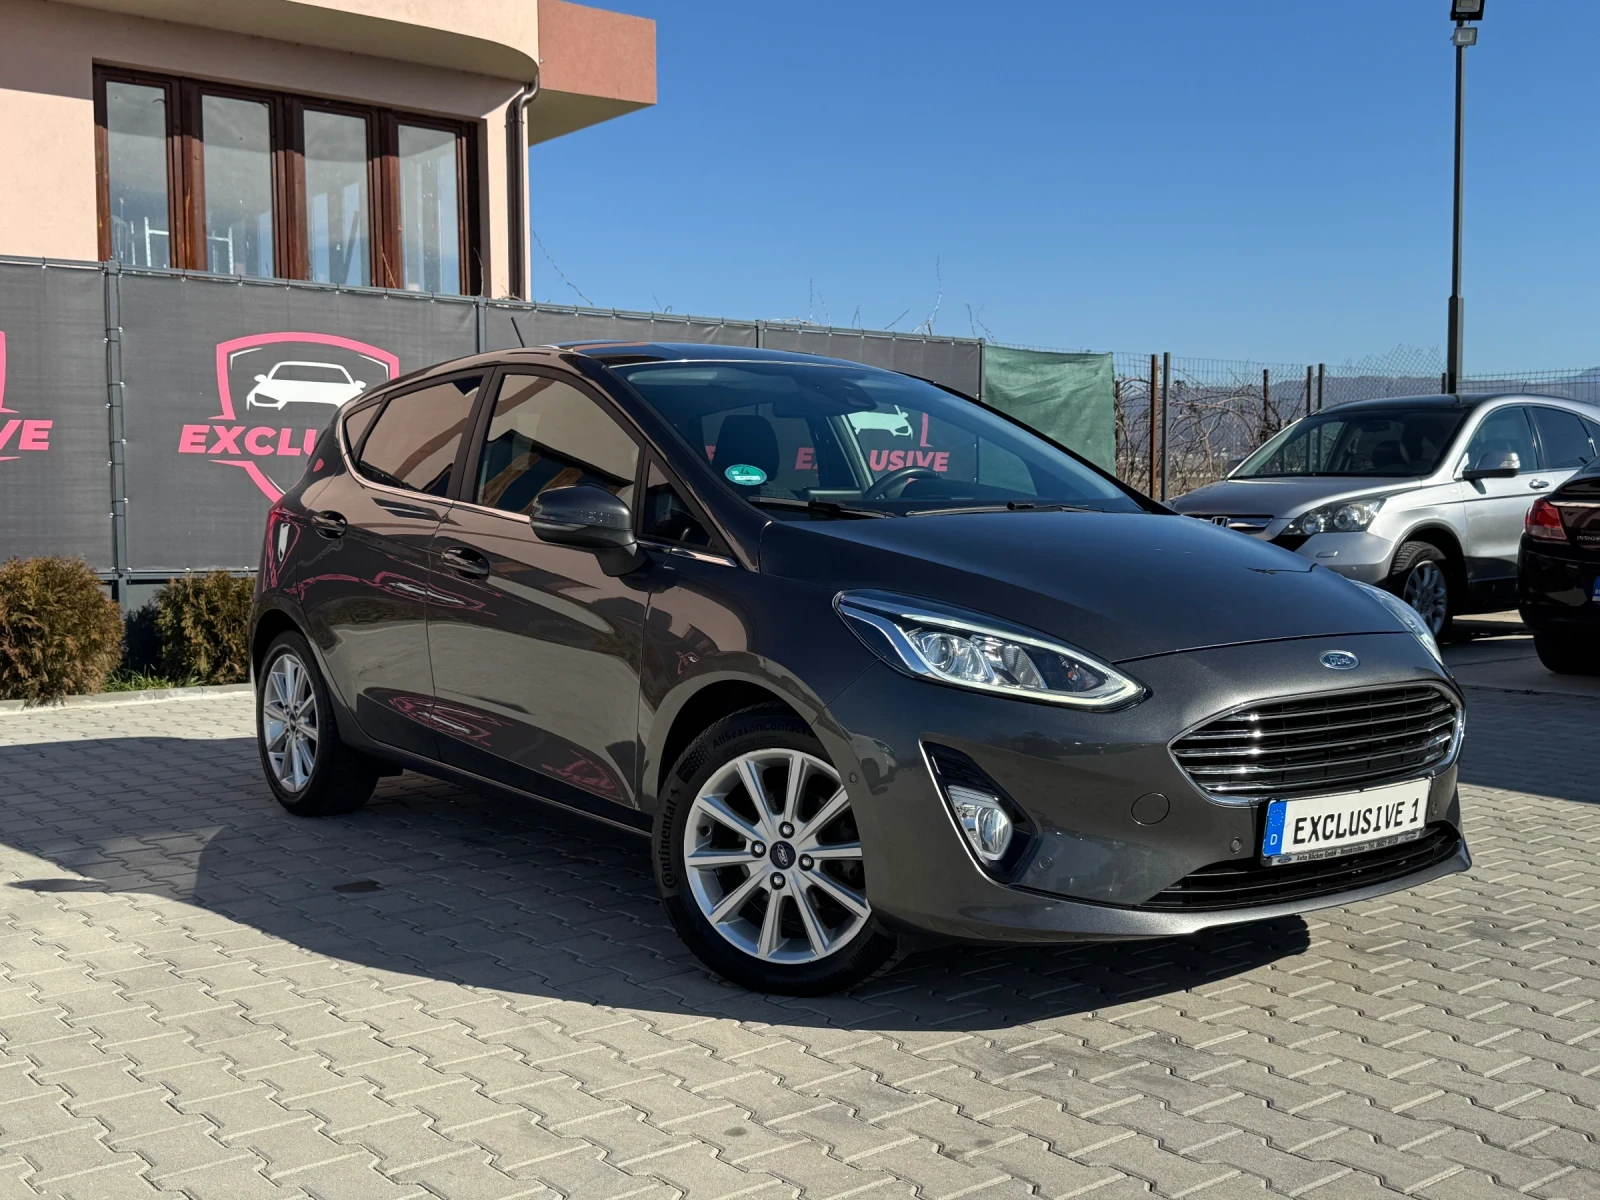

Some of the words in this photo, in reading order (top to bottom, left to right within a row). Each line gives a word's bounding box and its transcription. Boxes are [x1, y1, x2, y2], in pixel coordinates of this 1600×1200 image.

[1328, 654, 1351, 666] Ford
[712, 721, 806, 748] AllSeasonContact
[1293, 801, 1405, 844] EXCLUSIVE
[1409, 798, 1419, 823] 1
[658, 798, 678, 889] Continental
[1270, 834, 1277, 846] D
